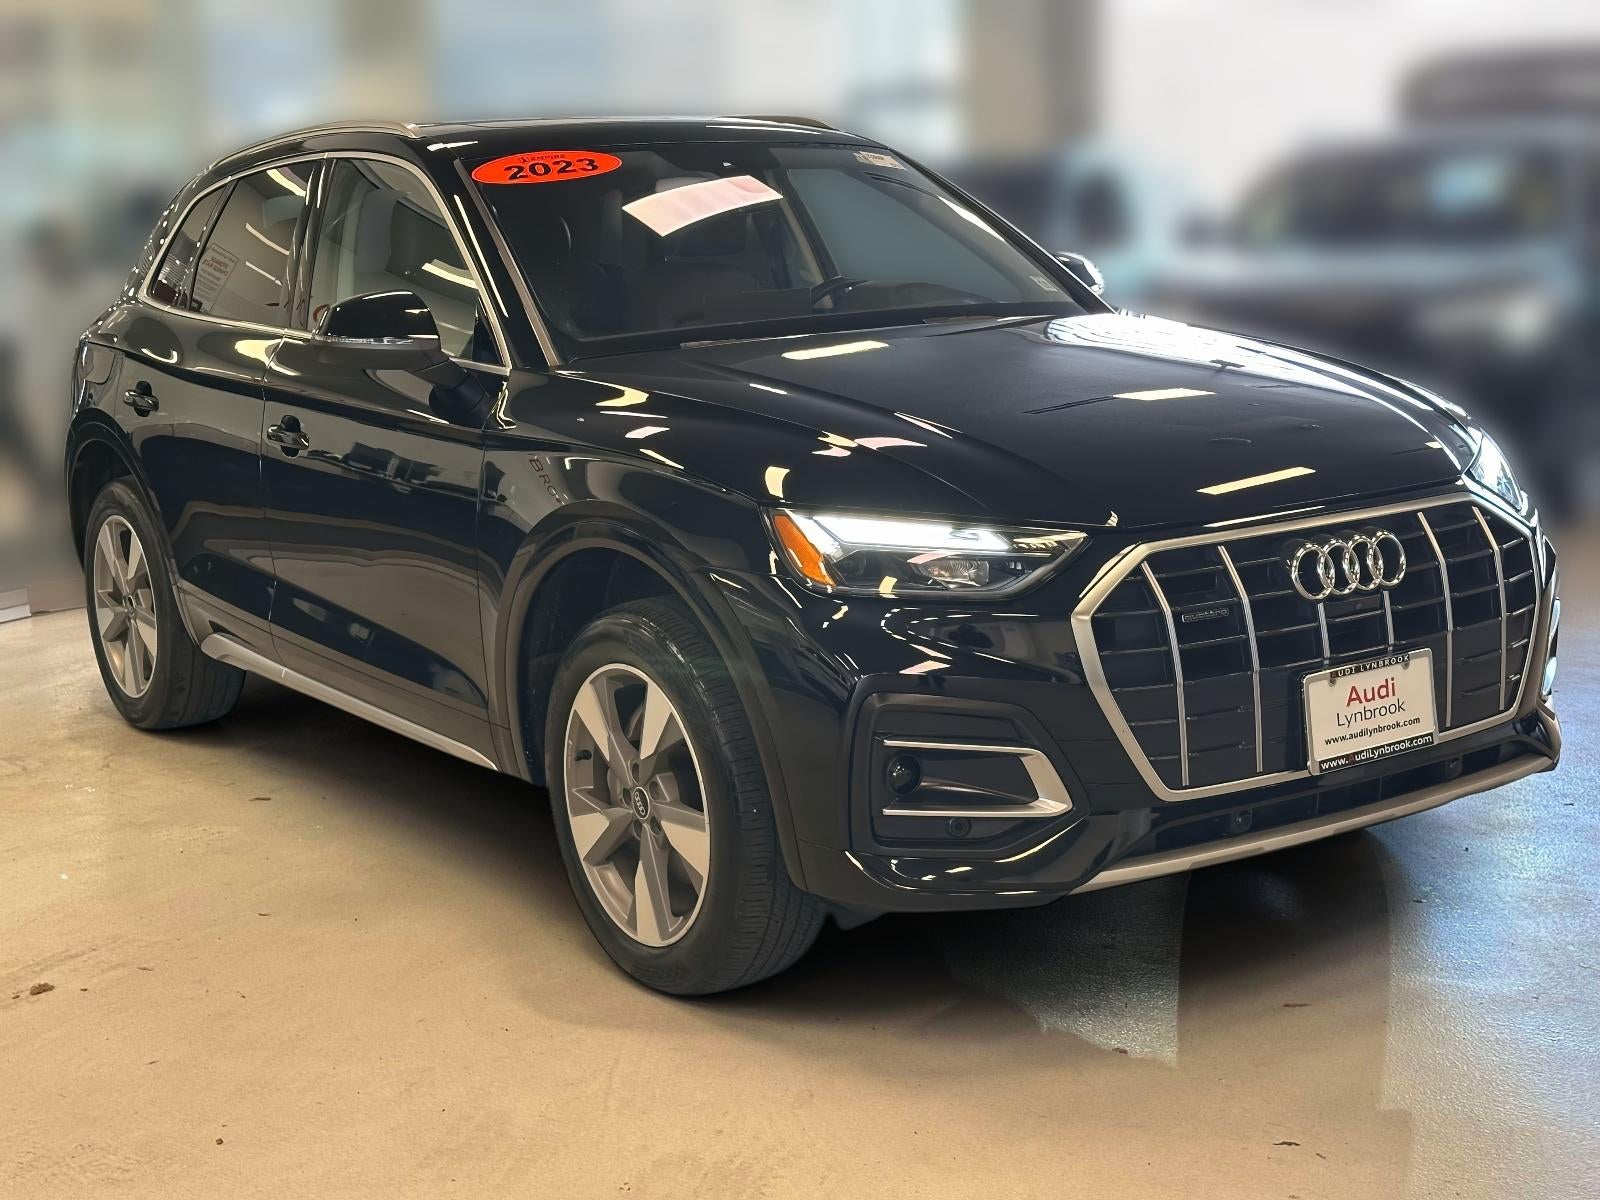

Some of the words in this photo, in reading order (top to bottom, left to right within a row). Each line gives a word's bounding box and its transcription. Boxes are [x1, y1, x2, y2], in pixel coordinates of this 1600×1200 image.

[504, 158, 598, 179] 2023
[1331, 667, 1355, 678] AUDI
[1360, 655, 1409, 672] LYNBROOK
[1346, 677, 1396, 706] Audi
[1337, 698, 1405, 728] Lynbrook
[1325, 717, 1420, 745] www.audilynbrook.com
[1321, 736, 1432, 769] www.AudiLynbrook.com
